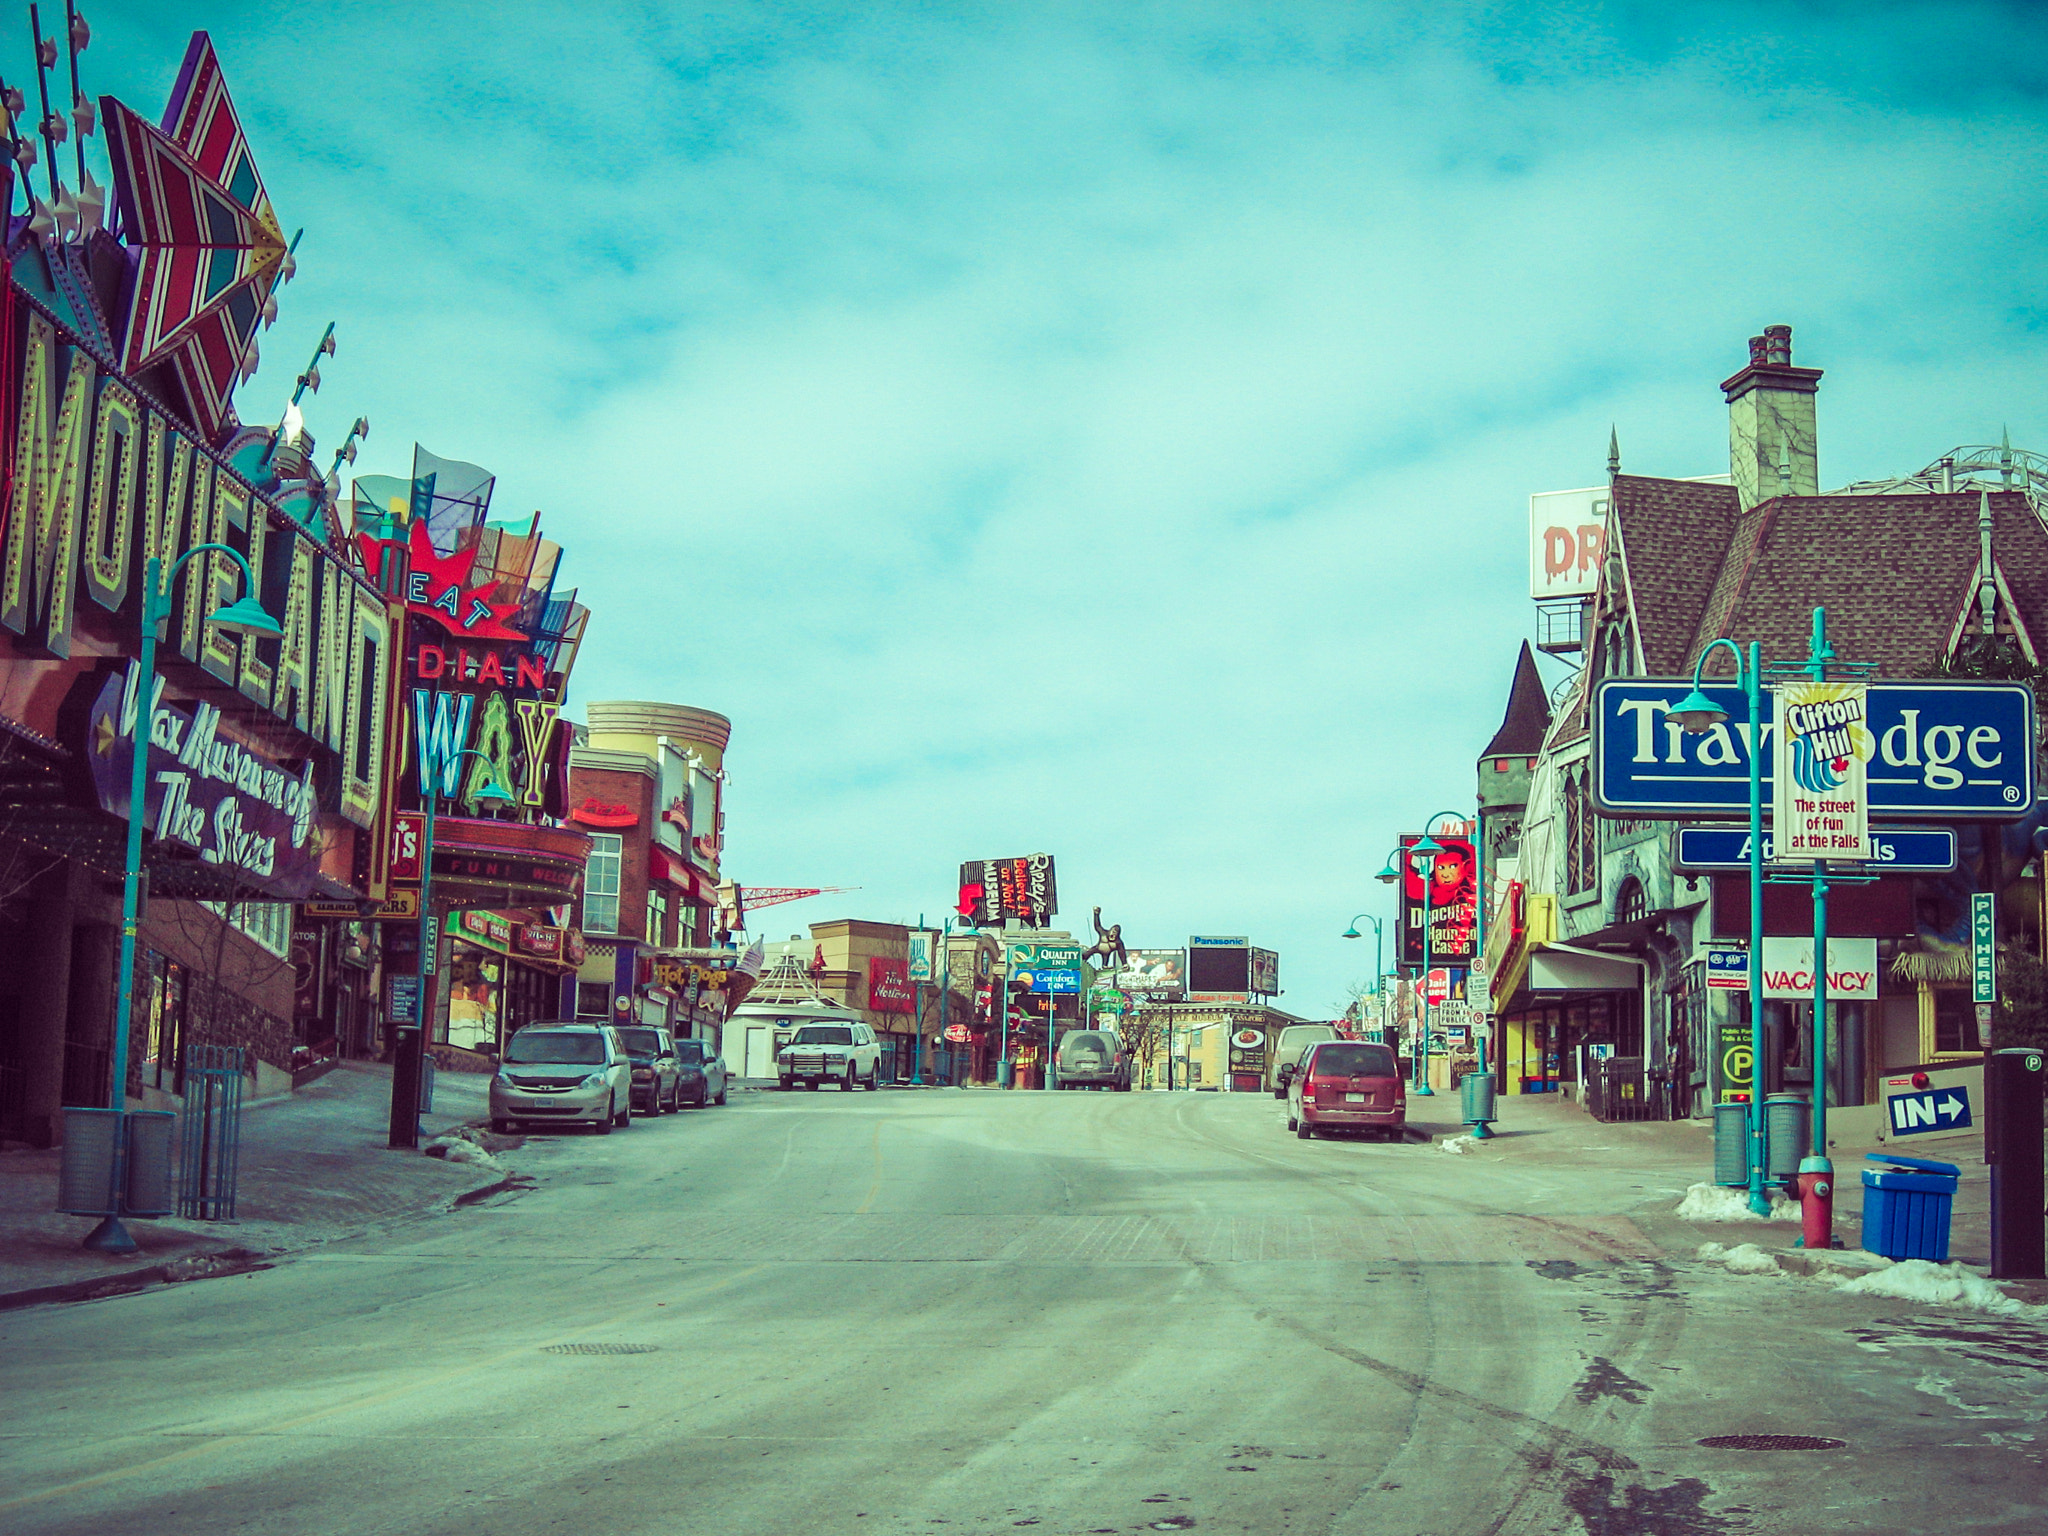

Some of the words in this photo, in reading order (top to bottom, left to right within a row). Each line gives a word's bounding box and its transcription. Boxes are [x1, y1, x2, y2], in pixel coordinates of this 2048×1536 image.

[1, 309, 389, 830] MOVIELAND
[409, 572, 491, 629] EAT
[418, 644, 545, 690] DIAN
[1787, 697, 1861, 736] Clifton
[119, 656, 184, 755] Wax
[178, 700, 285, 809] Museum
[284, 758, 316, 848] of
[413, 688, 560, 817] WAY
[1810, 726, 1854, 763] Hill
[155, 771, 206, 847] The
[1794, 799, 1816, 813] The
[1819, 799, 1856, 813] street
[1806, 817, 1820, 831] of
[1823, 817, 1844, 831] fun
[200, 796, 276, 877] Stars
[1792, 834, 1805, 848] at
[1808, 834, 1828, 848] the
[1831, 834, 1860, 848] Falls
[983, 860, 1001, 922] MUSEUM
[1001, 867, 1011, 881] or
[1014, 859, 1028, 902] Believe
[1025, 852, 1050, 915] Ripley's
[1002, 882, 1016, 909] Not!
[1017, 905, 1031, 917] It
[1976, 901, 1991, 938] PAY
[1040, 949, 1079, 961] QUALITY
[1194, 936, 1244, 946] Panasonic
[657, 965, 685, 987] Hot
[1977, 943, 1991, 995] HERE
[1191, 995, 1217, 1003] ideas
[1218, 995, 1231, 1003] for
[1441, 1001, 1464, 1009] GREAT
[2029, 1057, 2040, 1068] P
[1893, 1095, 1938, 1130] IN
